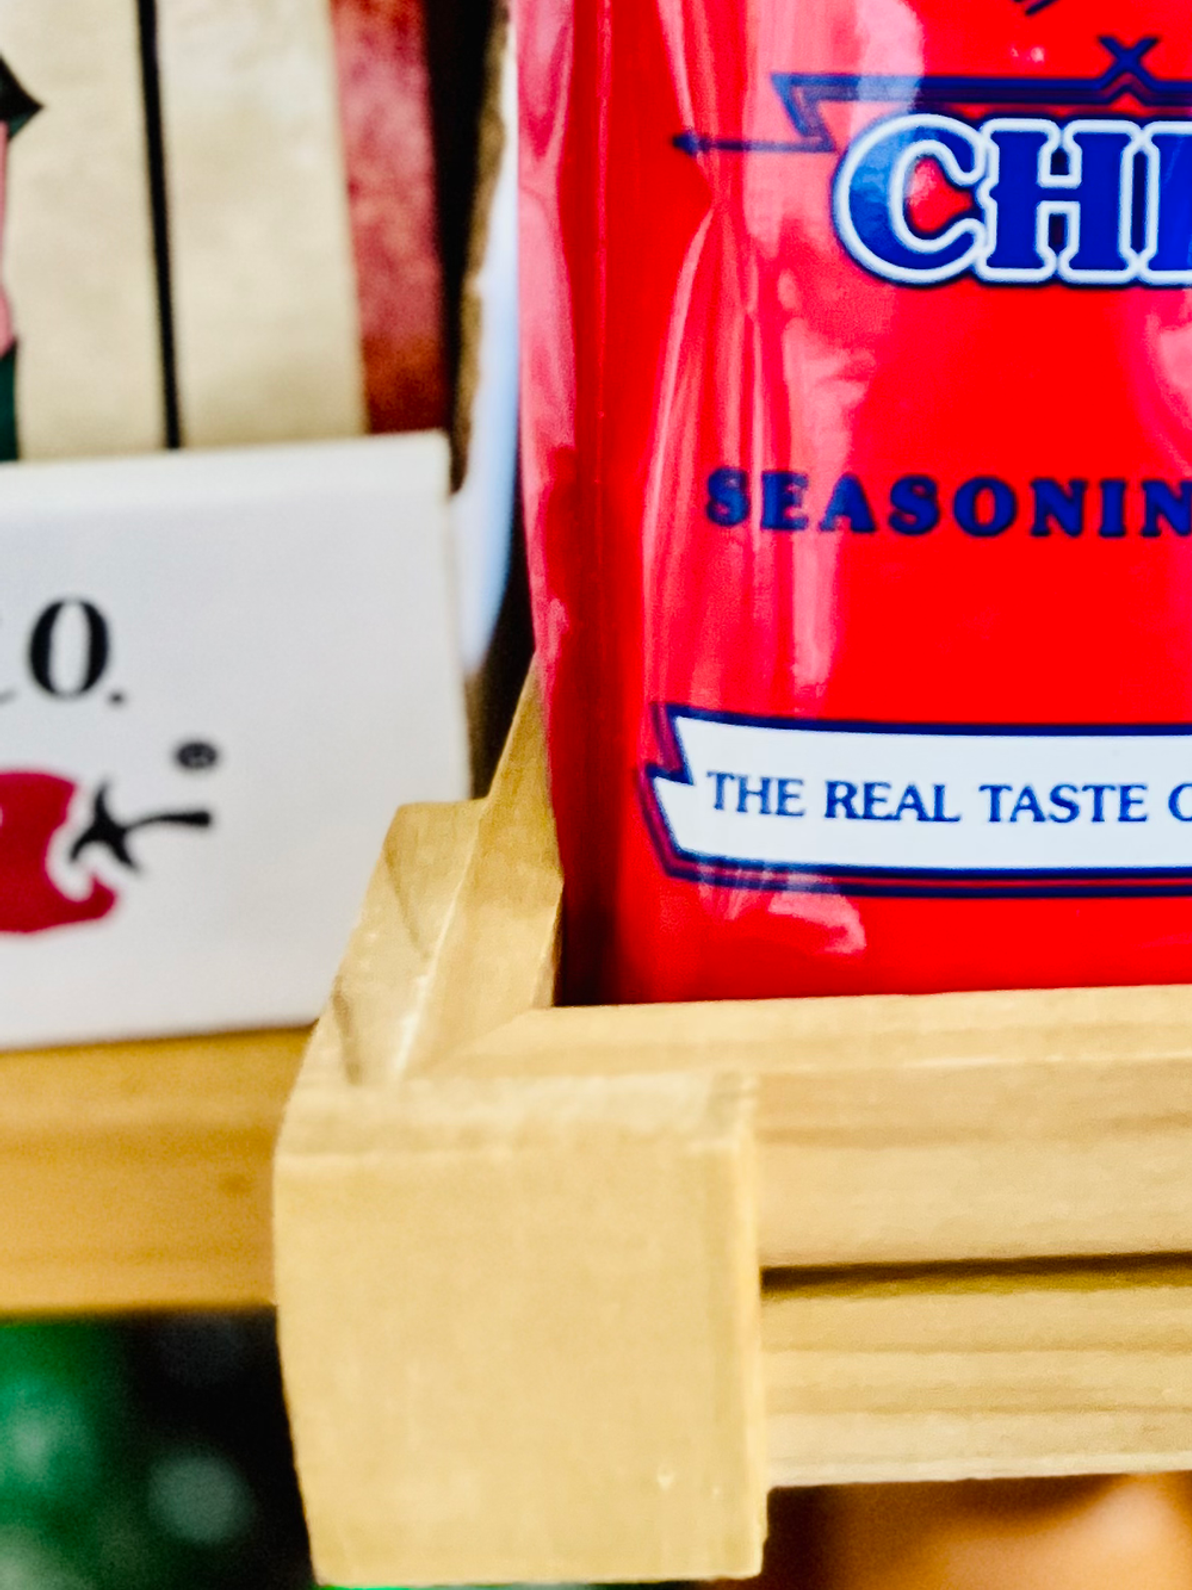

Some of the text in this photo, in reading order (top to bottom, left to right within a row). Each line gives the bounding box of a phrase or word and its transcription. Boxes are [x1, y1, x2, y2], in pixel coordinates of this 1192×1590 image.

[706, 768, 806, 818] THE
[823, 777, 961, 823] REAL
[978, 781, 1149, 825] TASTE
